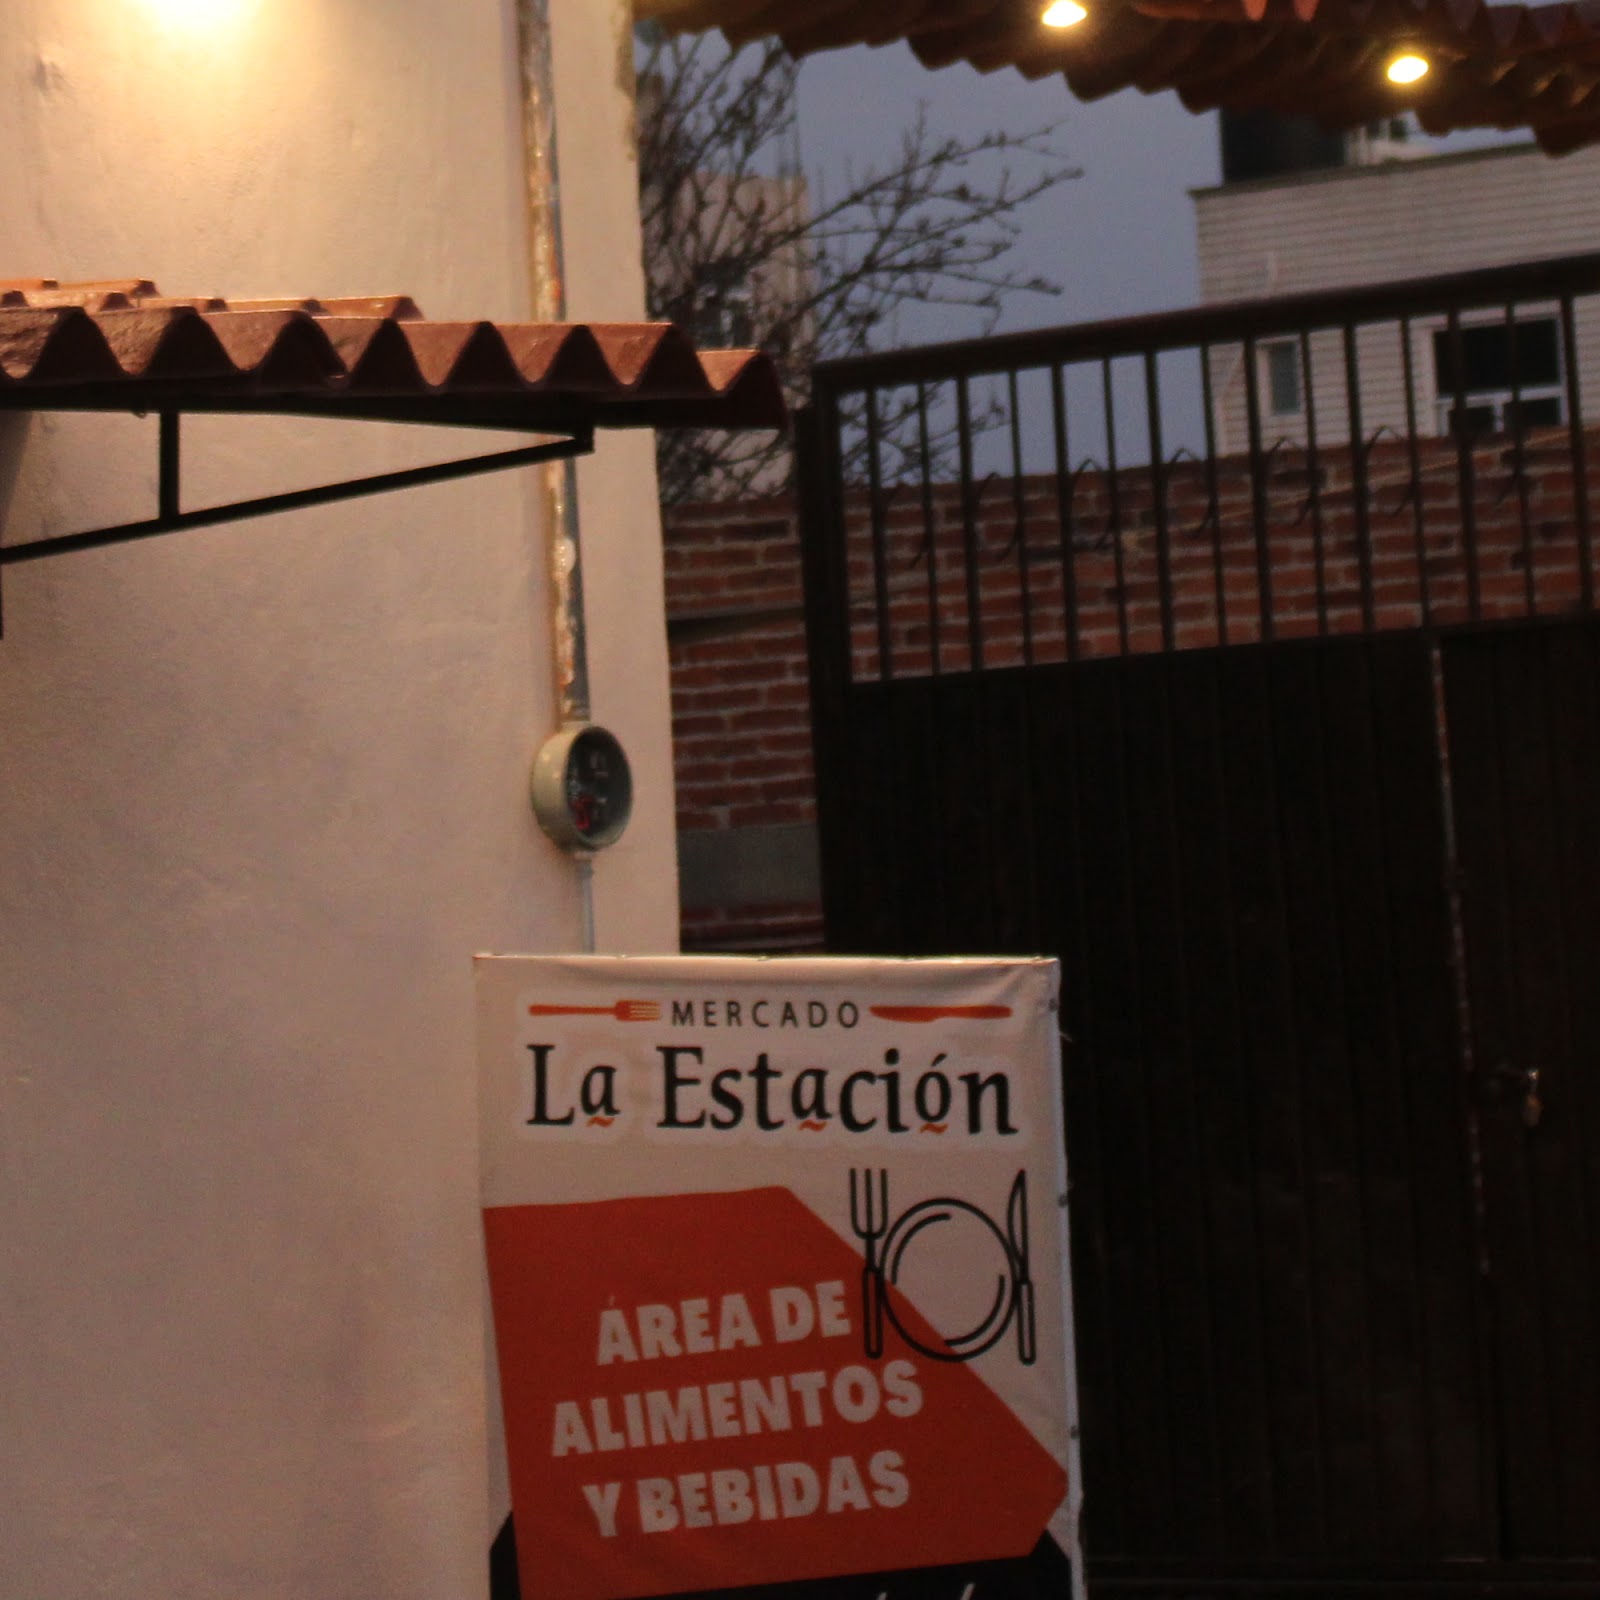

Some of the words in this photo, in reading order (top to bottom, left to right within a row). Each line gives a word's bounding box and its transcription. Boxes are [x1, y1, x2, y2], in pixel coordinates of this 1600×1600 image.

[671, 1000, 860, 1028] MERCADO
[525, 1043, 621, 1126] La
[655, 1045, 1019, 1135] Estación
[596, 1293, 761, 1367] ÁREA
[770, 1279, 852, 1344] DE
[551, 1359, 924, 1458] ALIMENTOS
[582, 1481, 625, 1538] Y
[637, 1449, 912, 1535] BEBIDAS
